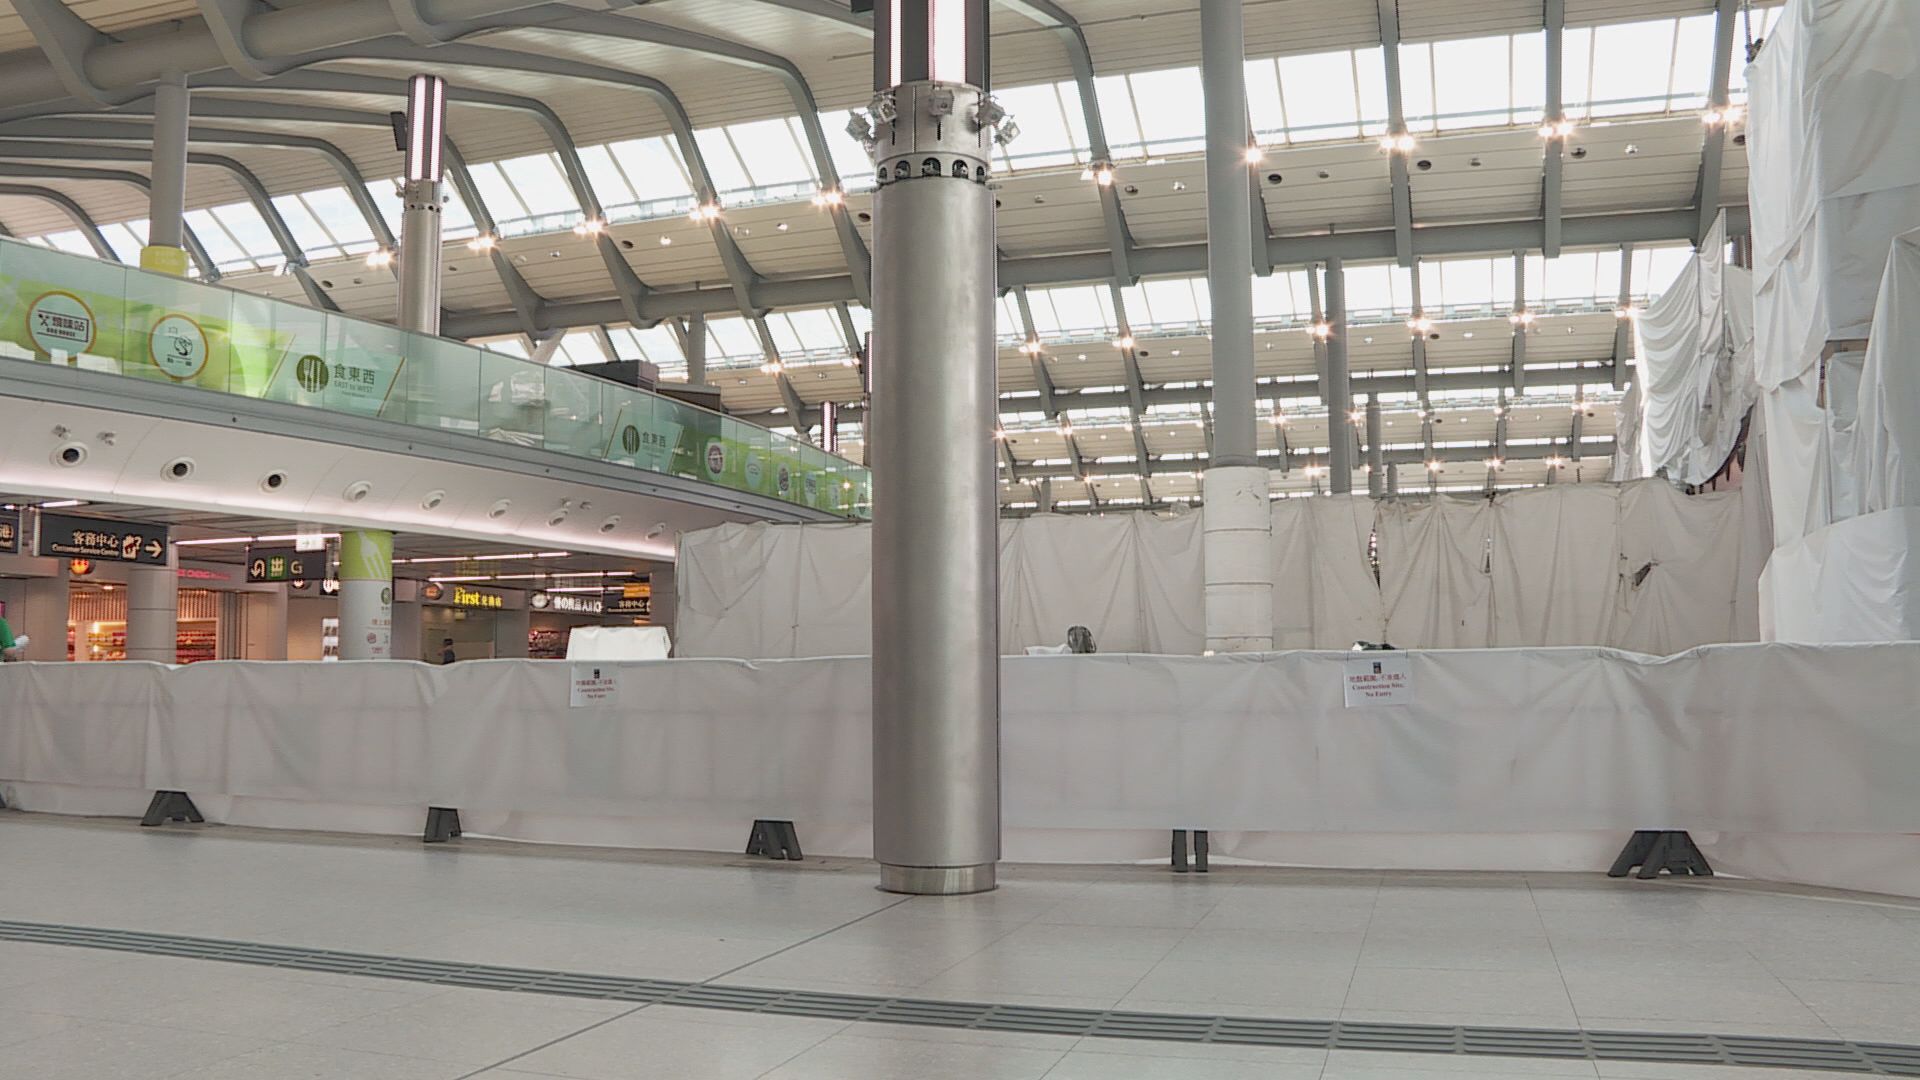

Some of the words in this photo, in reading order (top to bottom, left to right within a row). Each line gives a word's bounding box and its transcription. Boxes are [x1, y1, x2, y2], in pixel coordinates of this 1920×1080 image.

[334, 363, 375, 385] 食東西
[73, 530, 119, 548] 客務中心
[271, 557, 284, 571] 出
[454, 586, 480, 606] First
